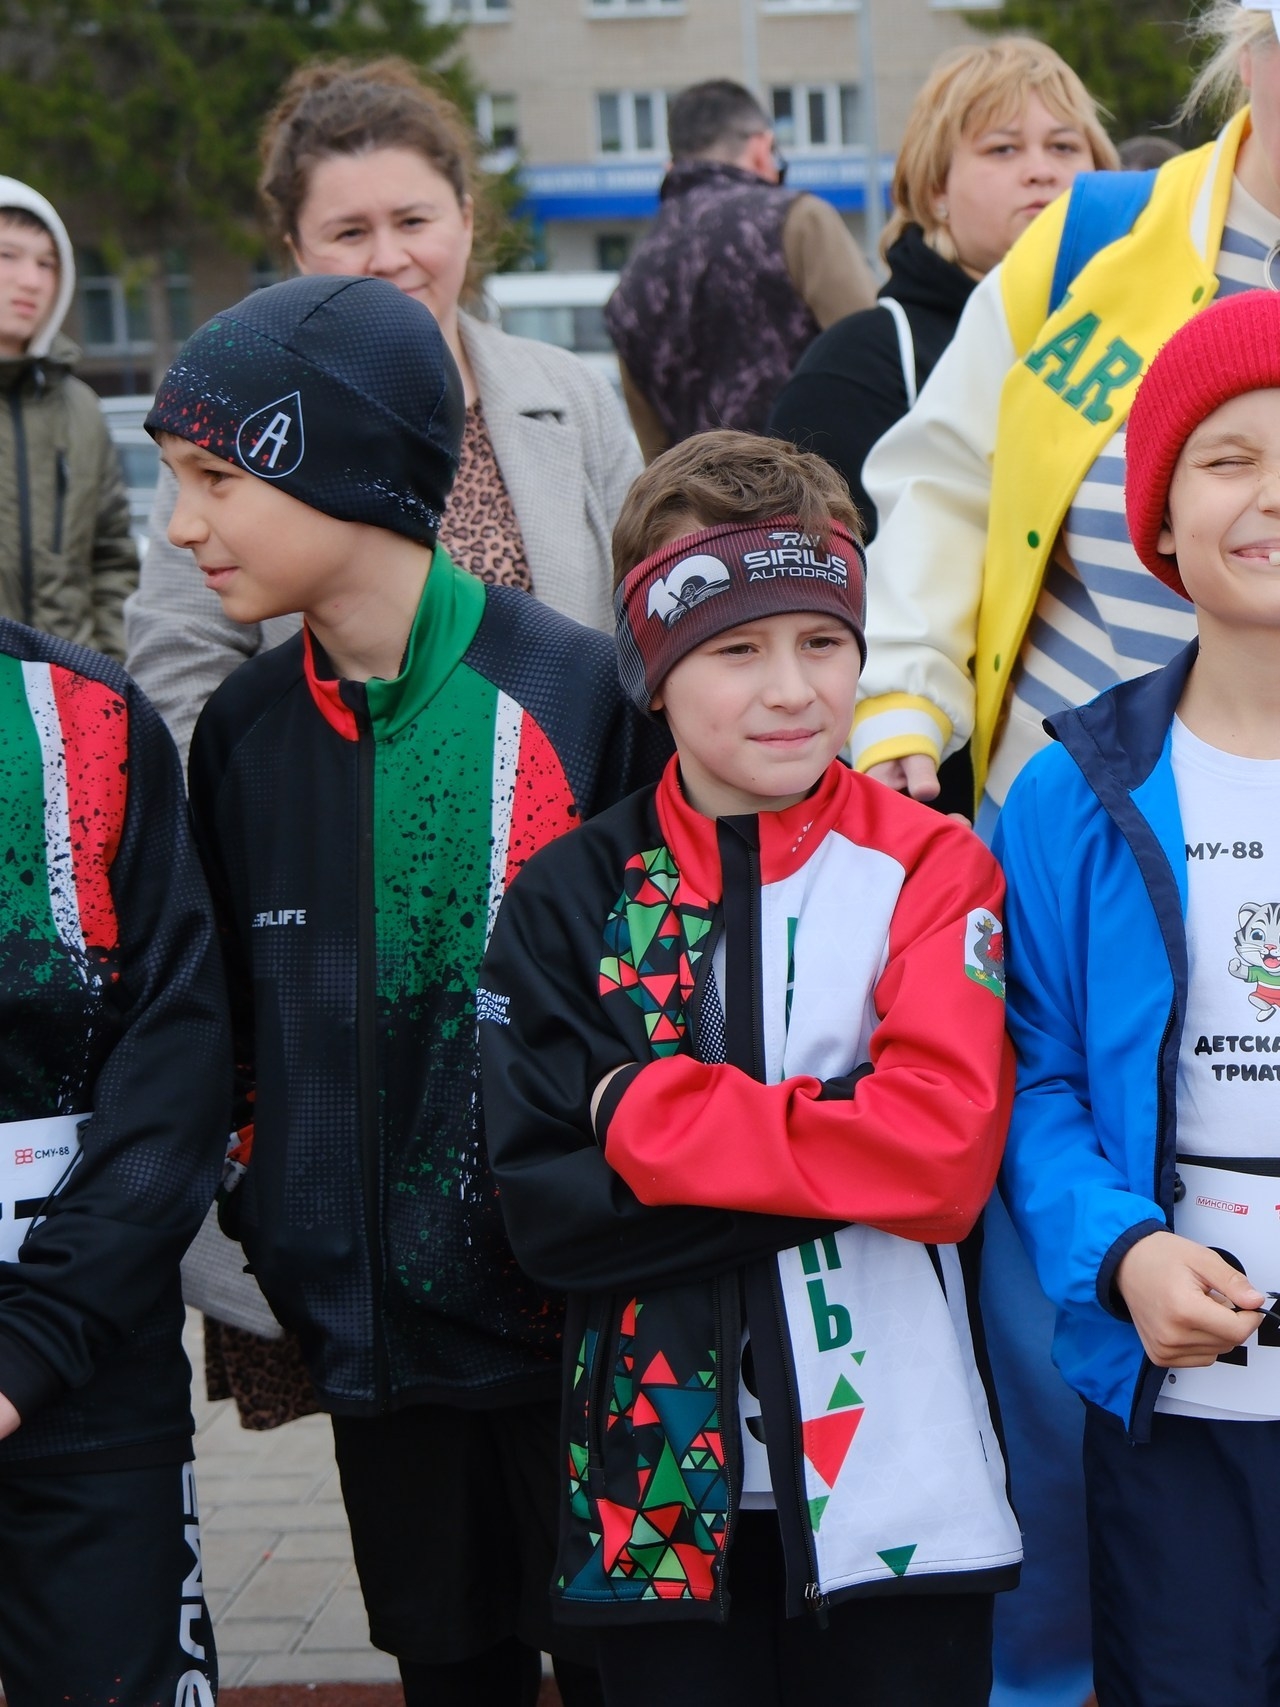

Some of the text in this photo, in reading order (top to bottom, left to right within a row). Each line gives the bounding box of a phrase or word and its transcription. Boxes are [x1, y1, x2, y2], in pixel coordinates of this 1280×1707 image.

[1024, 292, 1144, 426] AR
[743, 549, 847, 576] SIRIUS
[749, 567, 847, 588] AUTODROM
[1197, 1197, 1248, 1214] МИНСПОРТ
